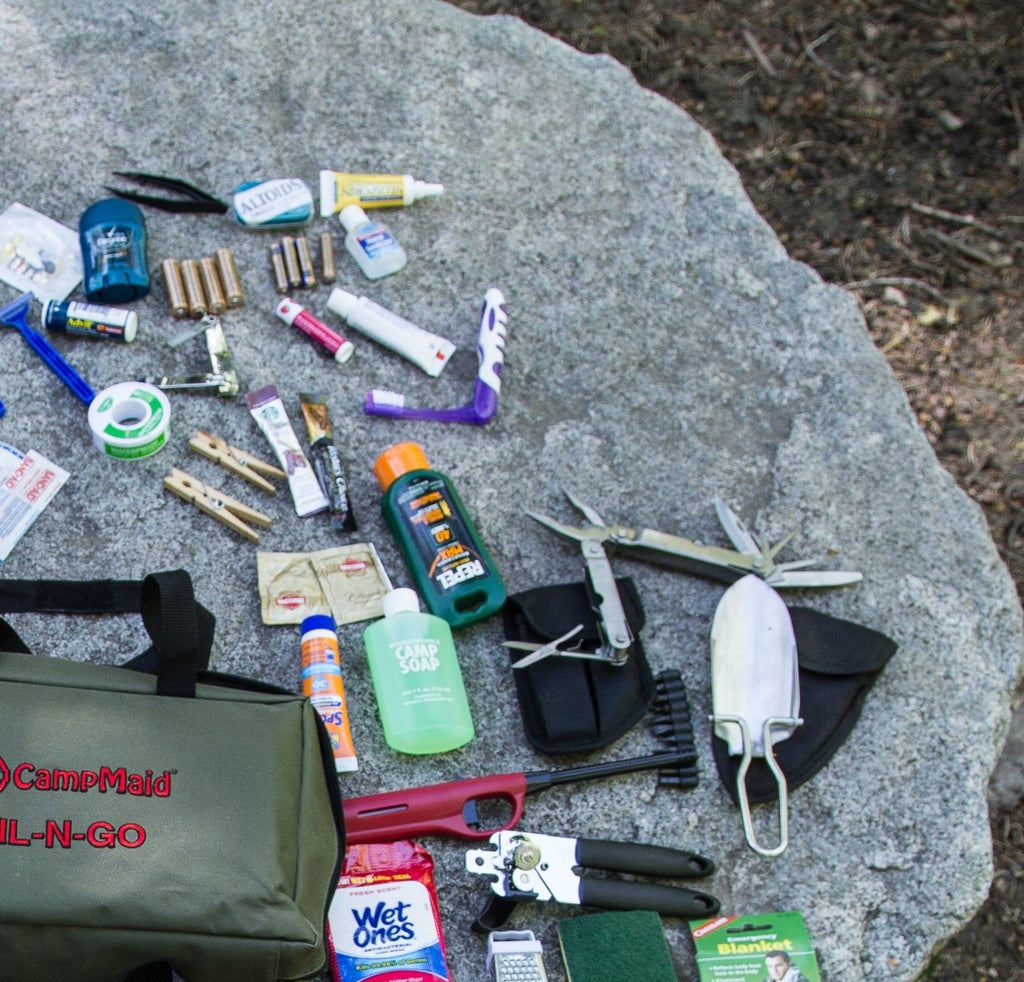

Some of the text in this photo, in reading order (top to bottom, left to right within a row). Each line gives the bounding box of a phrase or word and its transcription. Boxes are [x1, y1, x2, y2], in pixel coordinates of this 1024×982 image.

[241, 179, 303, 214] ALTOIDS
[436, 560, 485, 589] REPEL
[395, 643, 439, 660] CAMP
[399, 657, 441, 674] SOAP
[350, 886, 402, 897] FRESH SCENT
[352, 901, 412, 929] Wet
[353, 922, 414, 948] Ones
[727, 933, 777, 943] Emergency
[717, 939, 793, 955] Blanket
